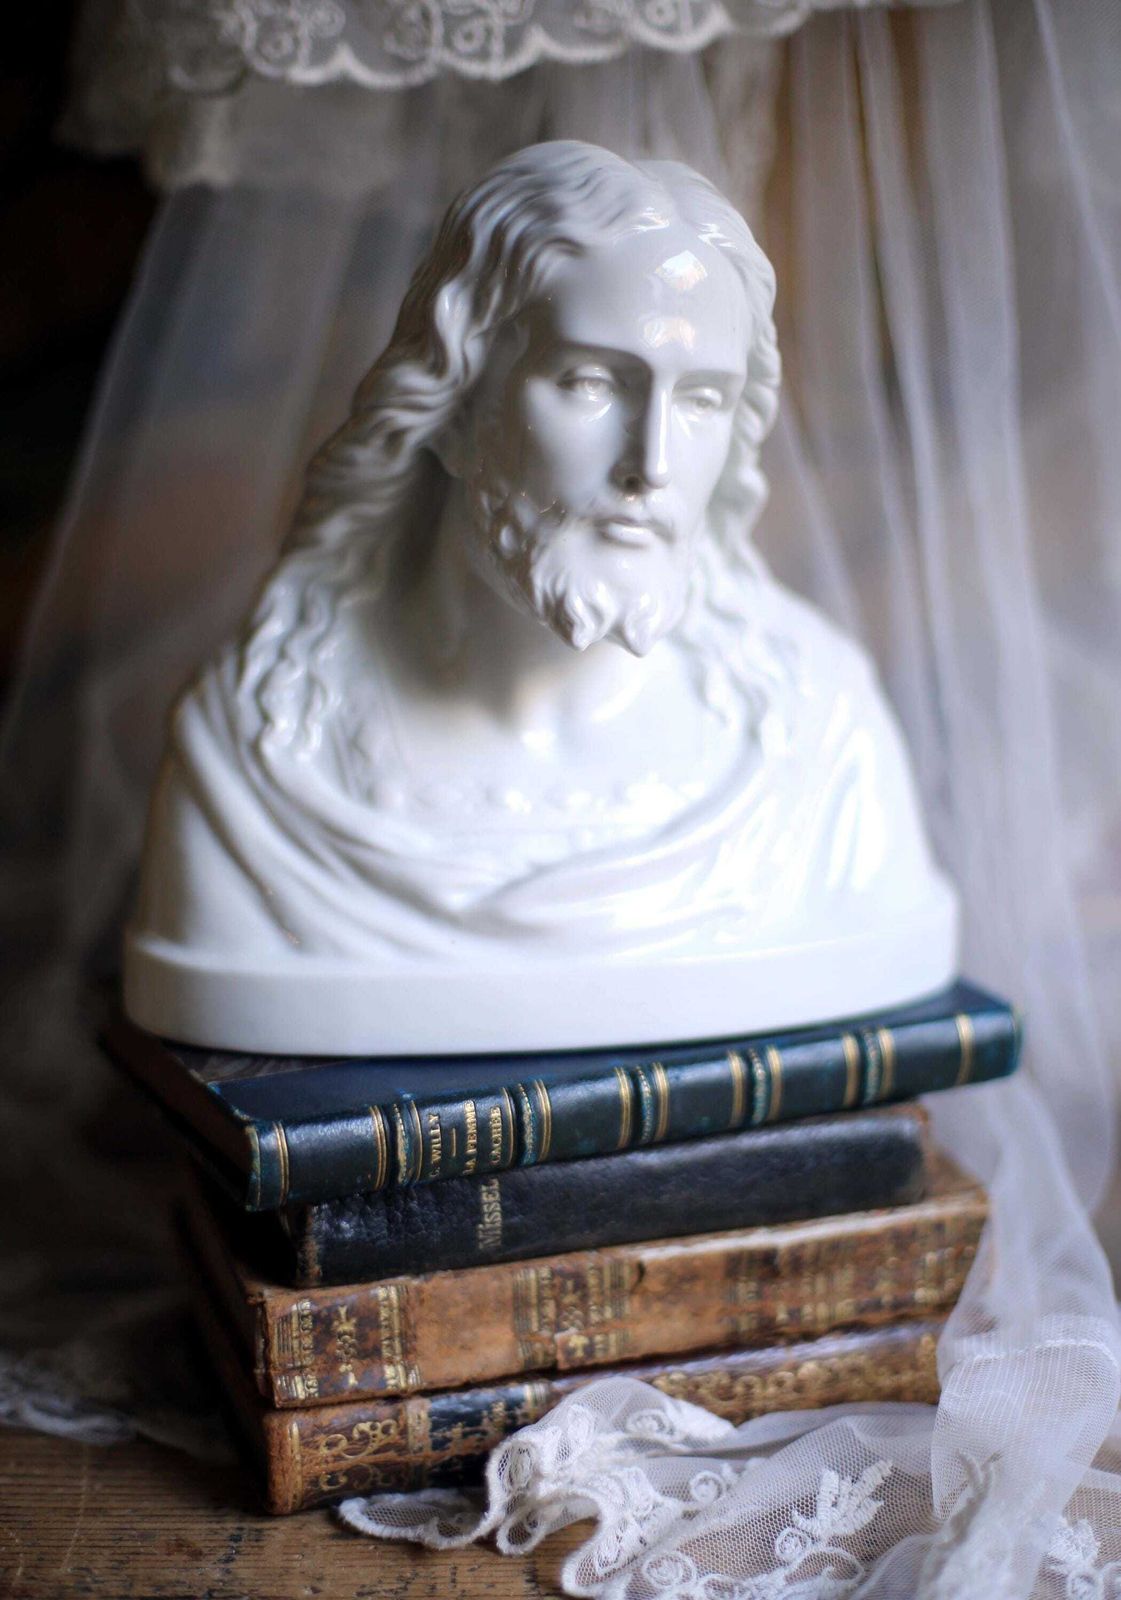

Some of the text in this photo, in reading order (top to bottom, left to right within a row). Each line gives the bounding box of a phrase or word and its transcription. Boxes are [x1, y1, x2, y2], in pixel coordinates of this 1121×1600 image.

[428, 1114, 442, 1164] WILLY
[462, 1099, 477, 1175] LA FEMME
